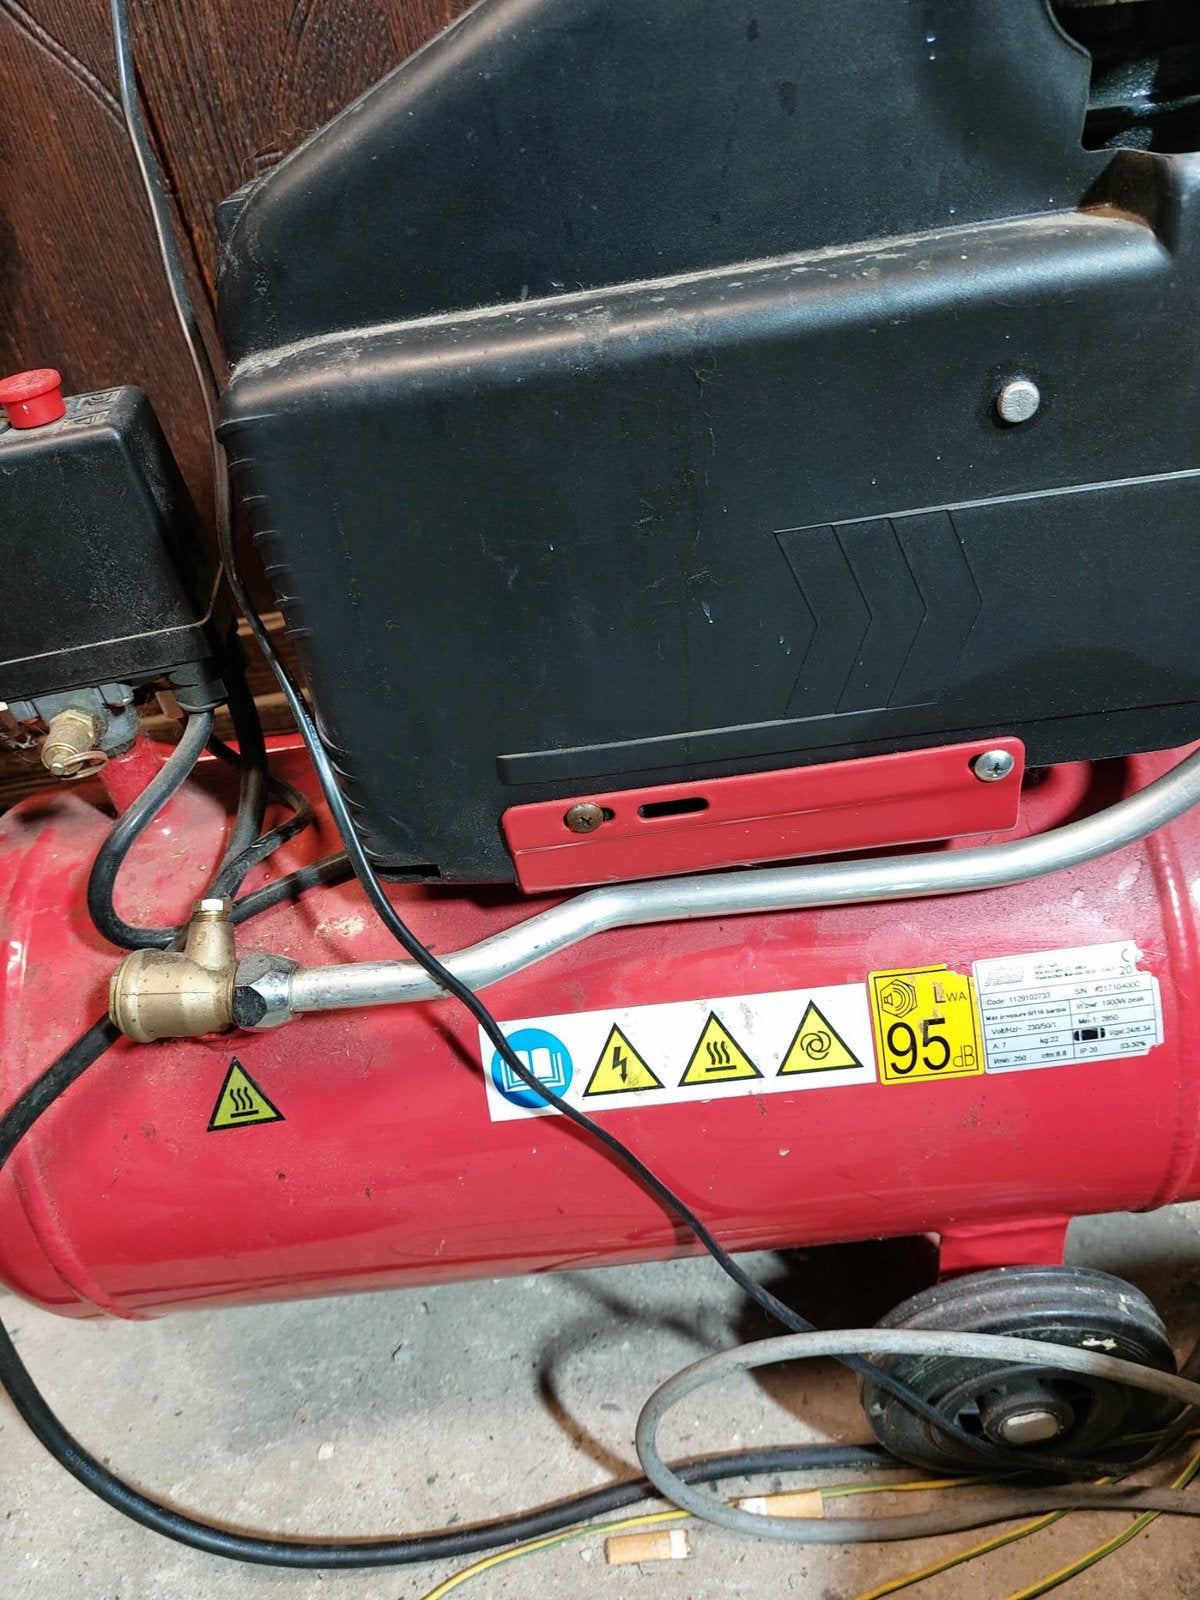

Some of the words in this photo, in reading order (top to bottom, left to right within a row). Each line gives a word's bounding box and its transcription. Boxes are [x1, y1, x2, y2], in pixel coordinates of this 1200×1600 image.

[1009, 991, 1051, 1004] 1129102733
[1000, 1011, 1027, 1020] pressure
[887, 1018, 950, 1075] 95
[952, 1044, 975, 1068] dB
[1013, 1054, 1027, 1062] 250
